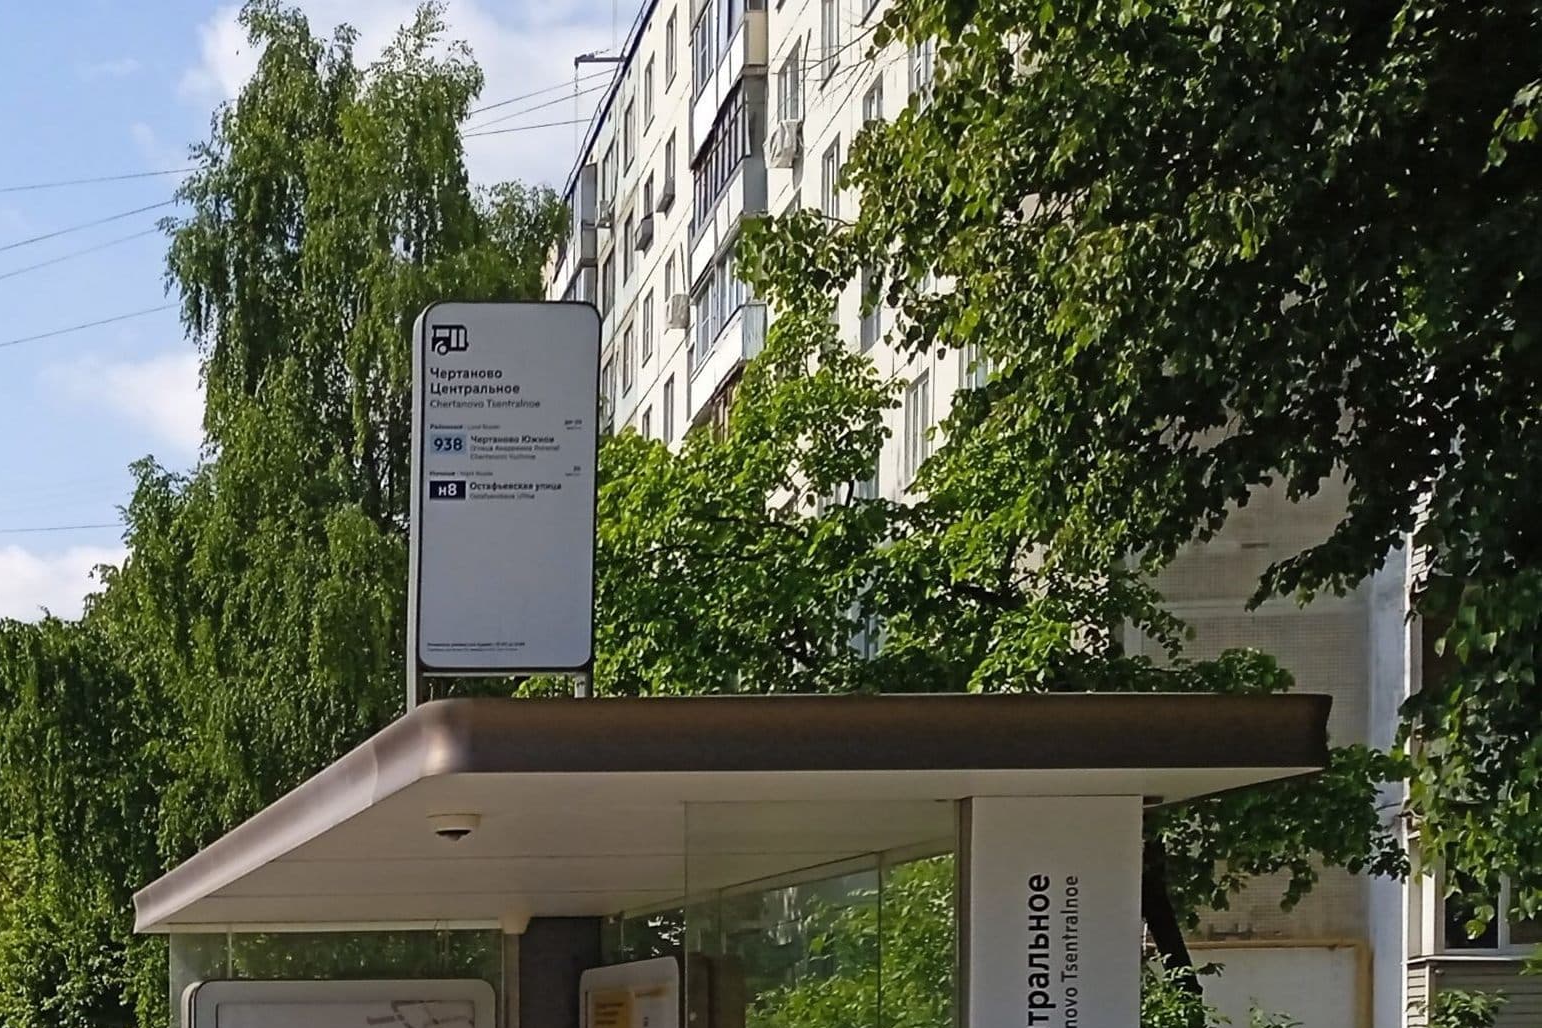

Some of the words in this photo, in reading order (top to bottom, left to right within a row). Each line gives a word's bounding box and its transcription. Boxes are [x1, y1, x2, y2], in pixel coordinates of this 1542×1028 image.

[429, 367, 503, 381] Чертаново
[429, 382, 521, 397] Центральное
[429, 400, 485, 409] Chertanovo
[486, 399, 541, 409] Tsentralnoe
[433, 437, 464, 452] 938
[1060, 875, 1079, 983] Tsentralnoe
